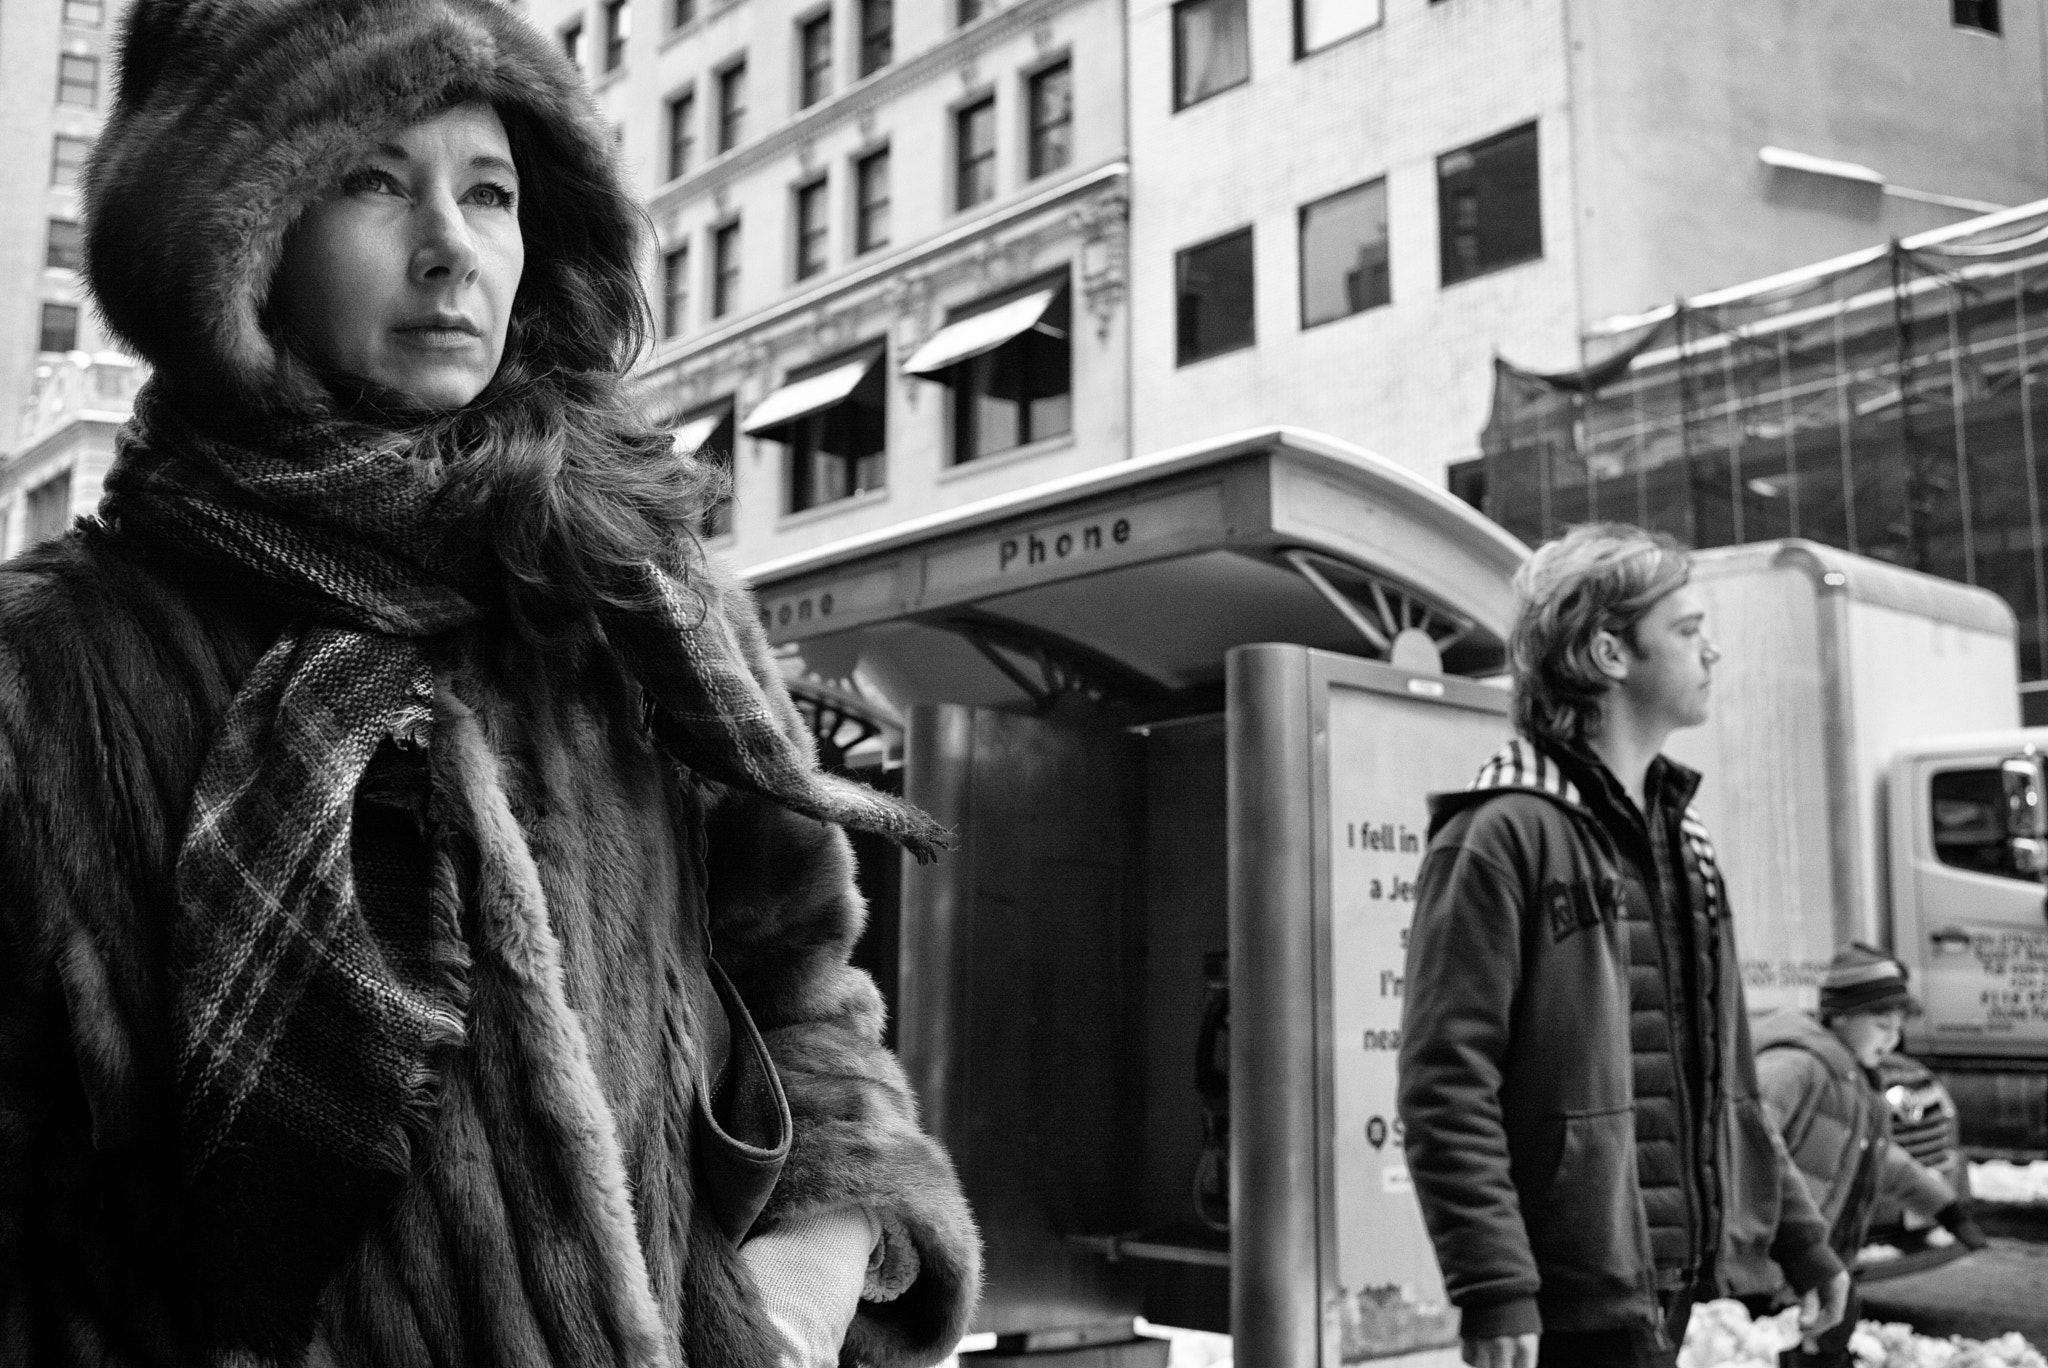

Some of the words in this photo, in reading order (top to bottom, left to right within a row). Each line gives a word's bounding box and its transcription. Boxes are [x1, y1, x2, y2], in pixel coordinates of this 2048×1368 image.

[1000, 517, 1132, 570] Phone
[759, 592, 835, 629] hone
[1348, 822, 1356, 849] I
[1361, 821, 1396, 851] fell
[1399, 824, 1419, 853] in
[1369, 878, 1382, 900] a
[1387, 875, 1416, 901] Je
[1363, 1029, 1401, 1051] nea
